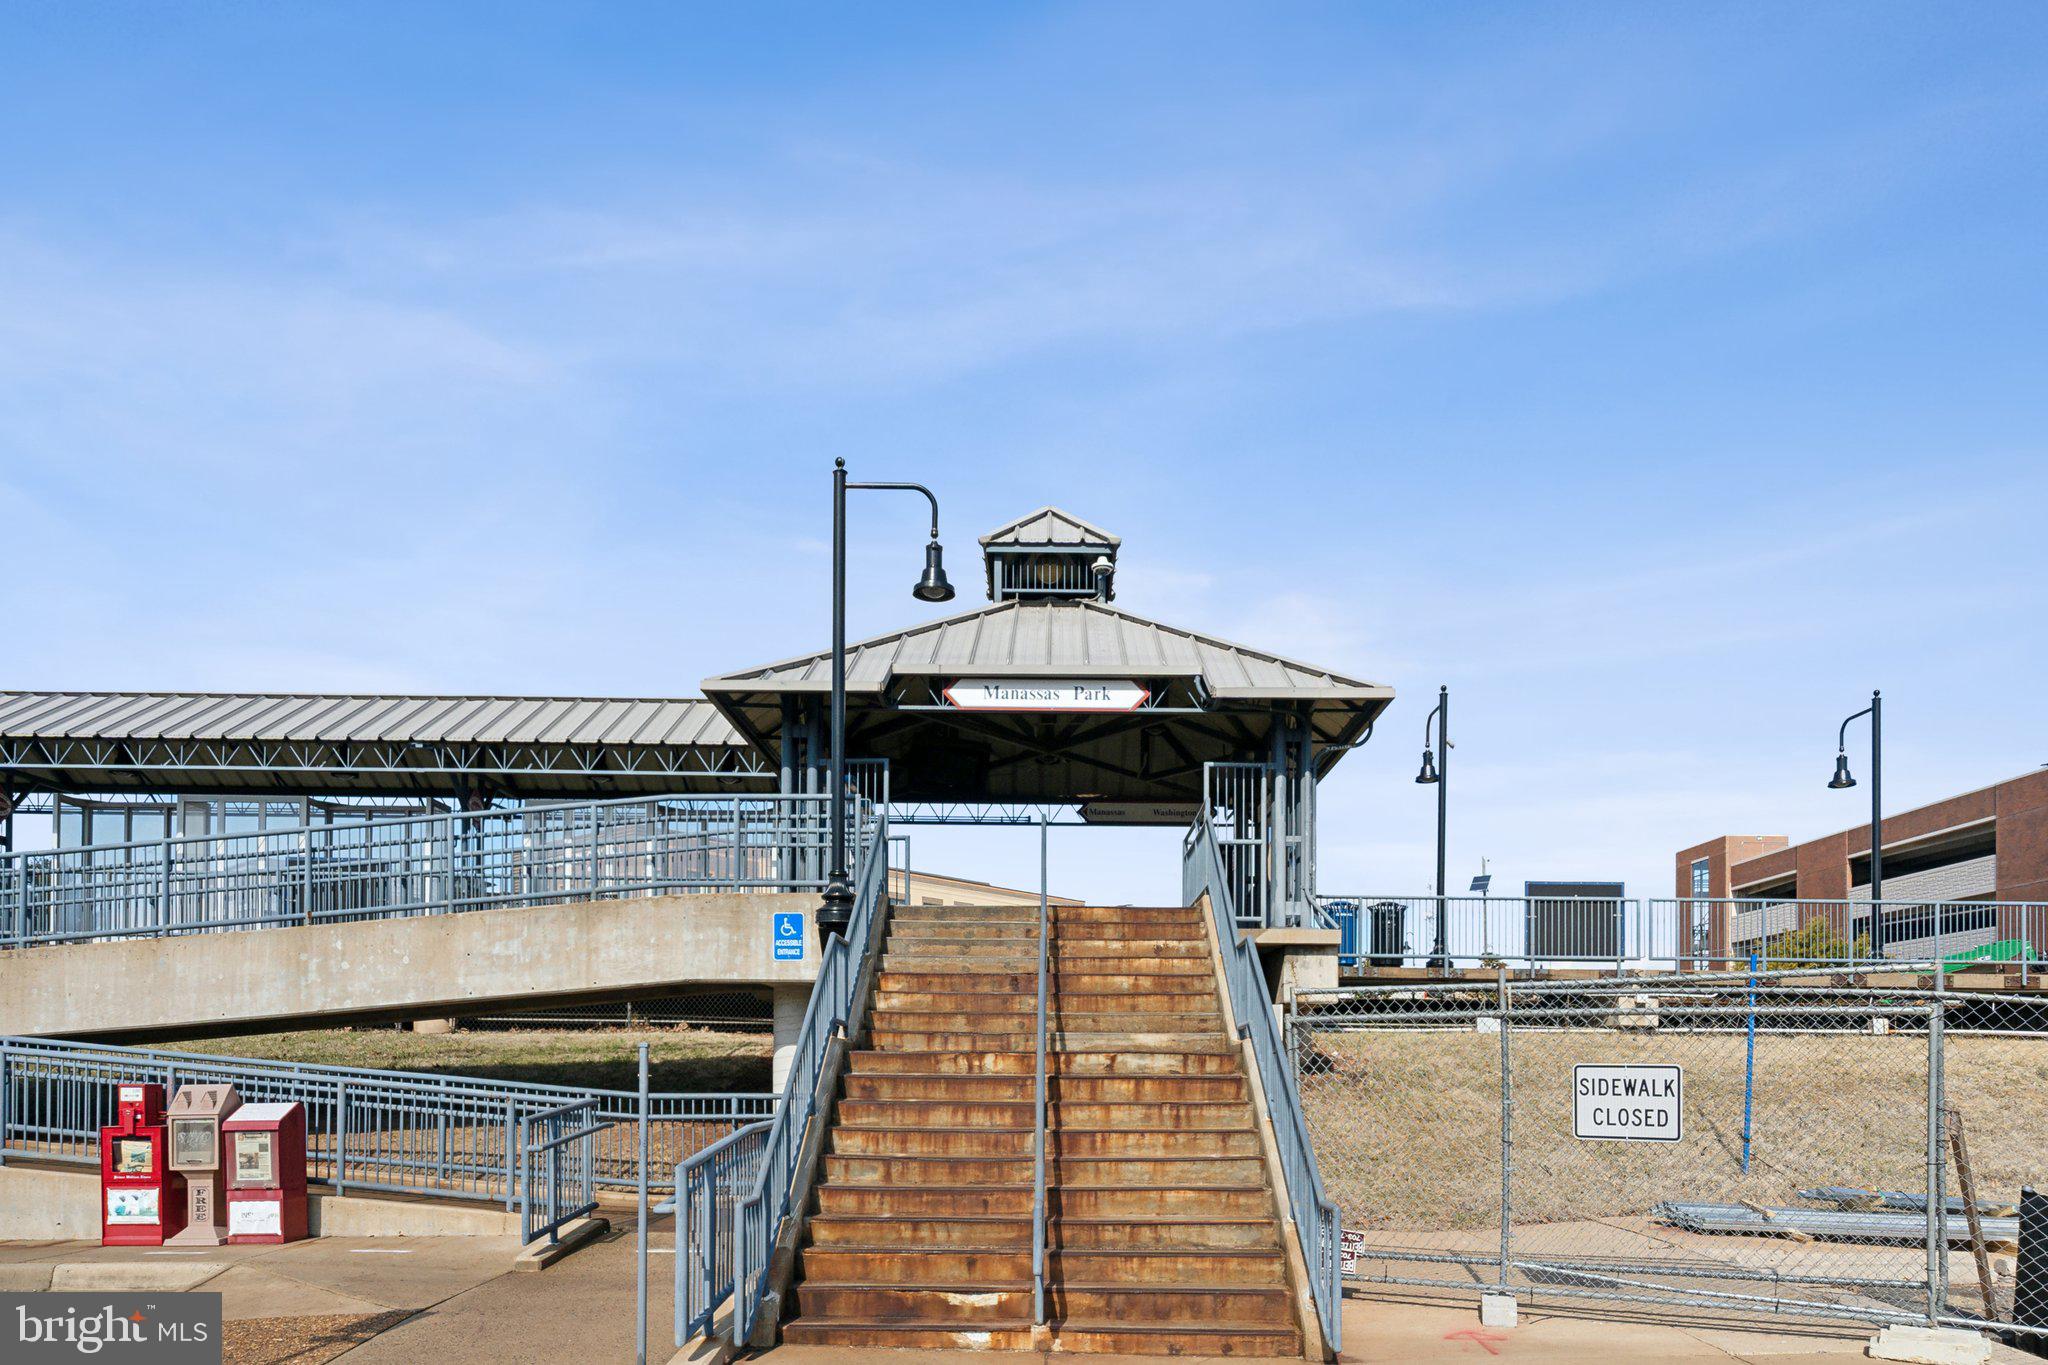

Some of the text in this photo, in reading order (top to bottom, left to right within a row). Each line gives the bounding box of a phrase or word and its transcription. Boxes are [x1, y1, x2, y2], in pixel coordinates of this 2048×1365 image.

[983, 685, 1111, 702] Manassas Park
[1088, 808, 1197, 818] Manassas Washington
[775, 939, 803, 947] ACCESSIBLE
[777, 948, 801, 956] ENTRANCE
[1579, 1078, 1676, 1098] SIDEWALK
[1593, 1107, 1669, 1128] CLOSED
[195, 1189, 207, 1221] FREE
